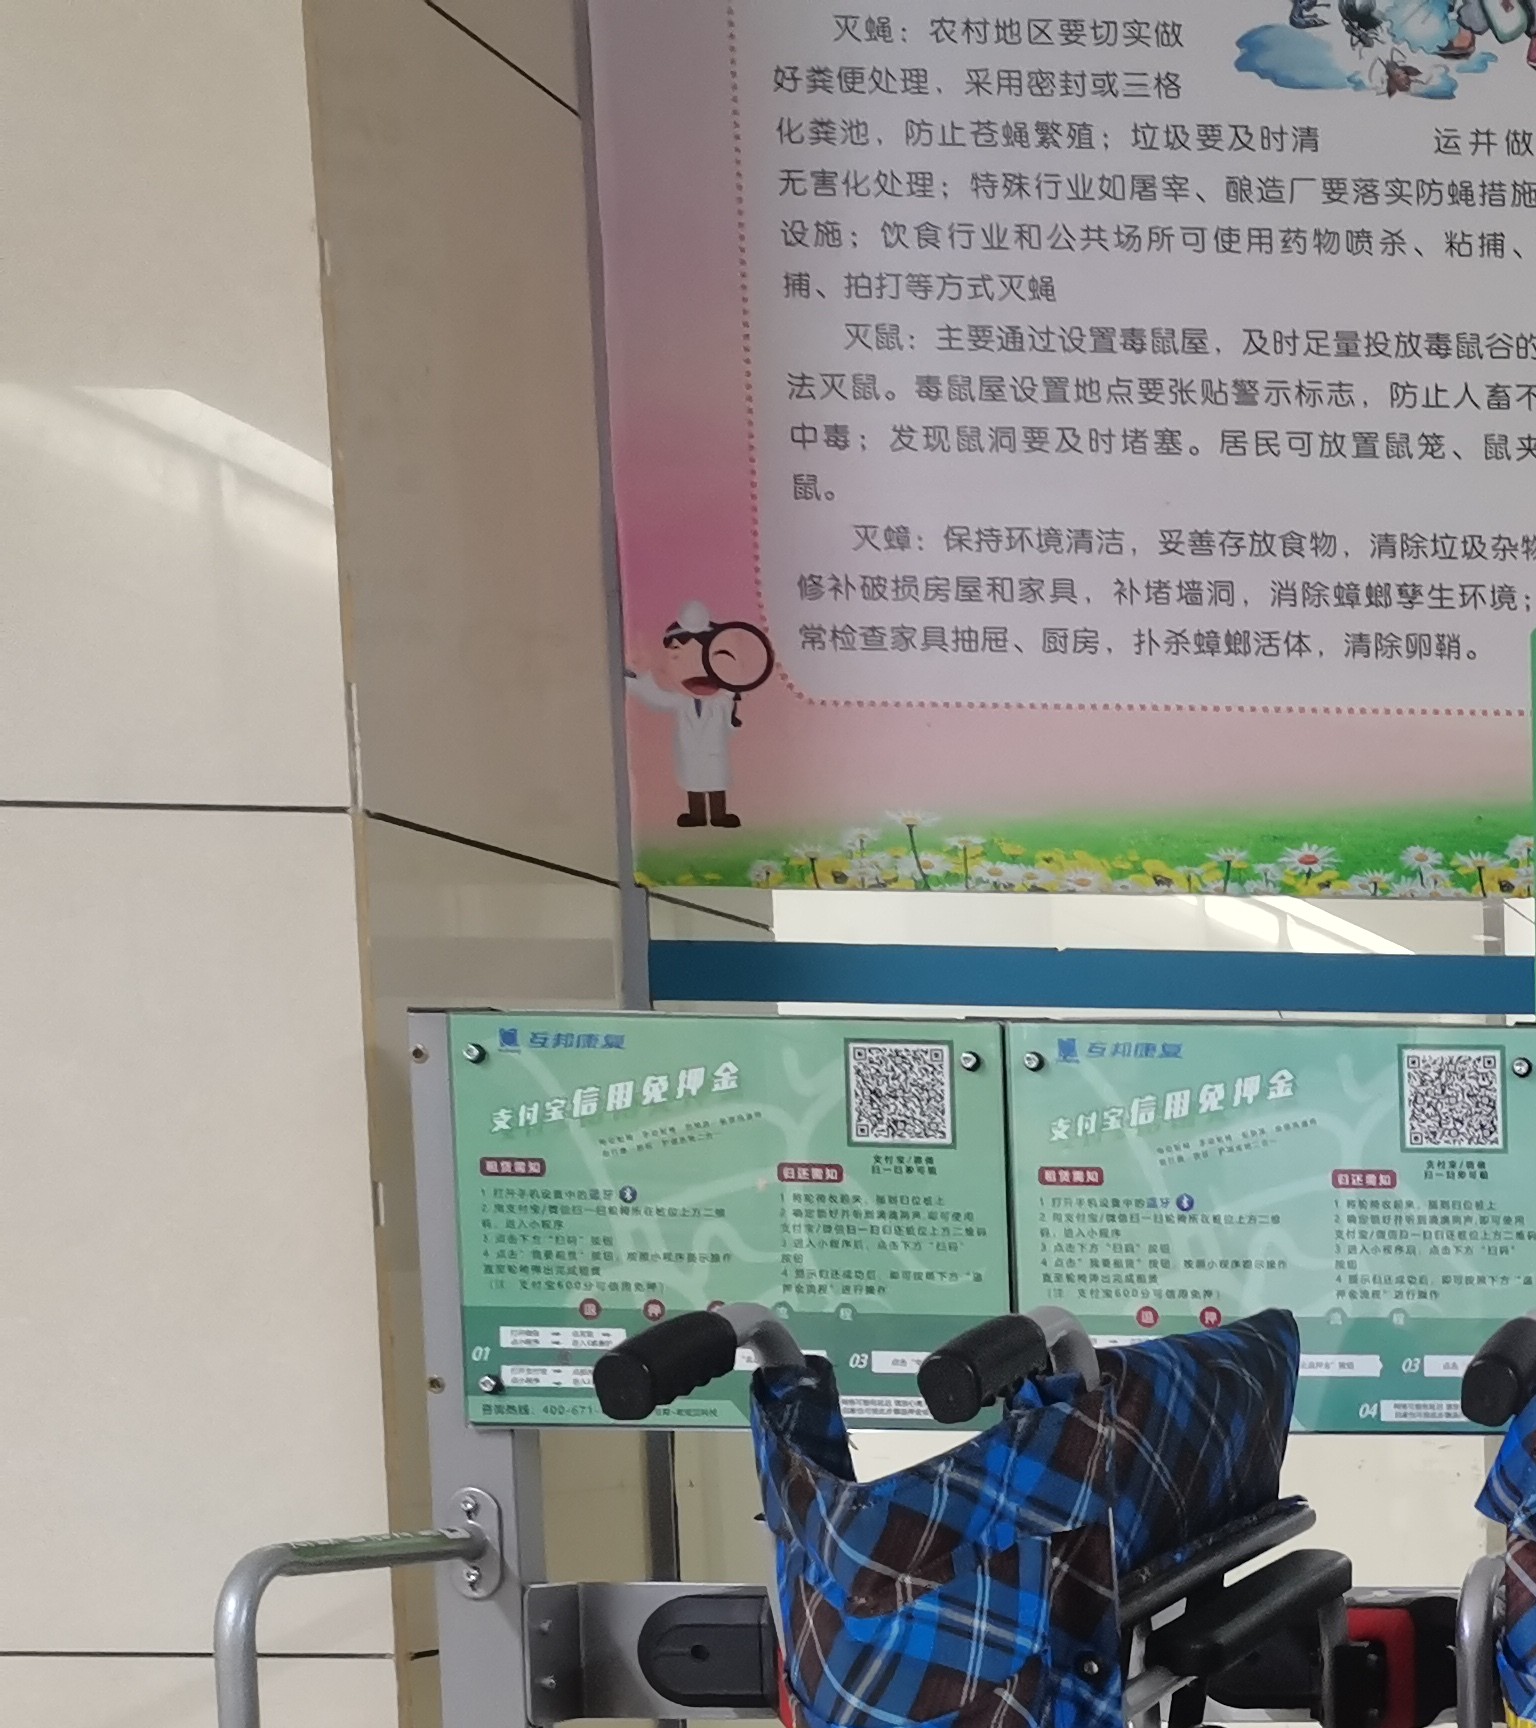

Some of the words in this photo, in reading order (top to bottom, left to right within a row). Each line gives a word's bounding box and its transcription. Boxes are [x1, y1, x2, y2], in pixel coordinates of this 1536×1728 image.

[783, 271, 1057, 303] 捕、拍打等方式灭蝇
[792, 473, 836, 502] 鼠。
[528, 1033, 626, 1050] 互邦康复
[490, 1061, 740, 1133] 支付宝信用免押金
[1048, 1069, 1297, 1142] 支付宝信用免押金
